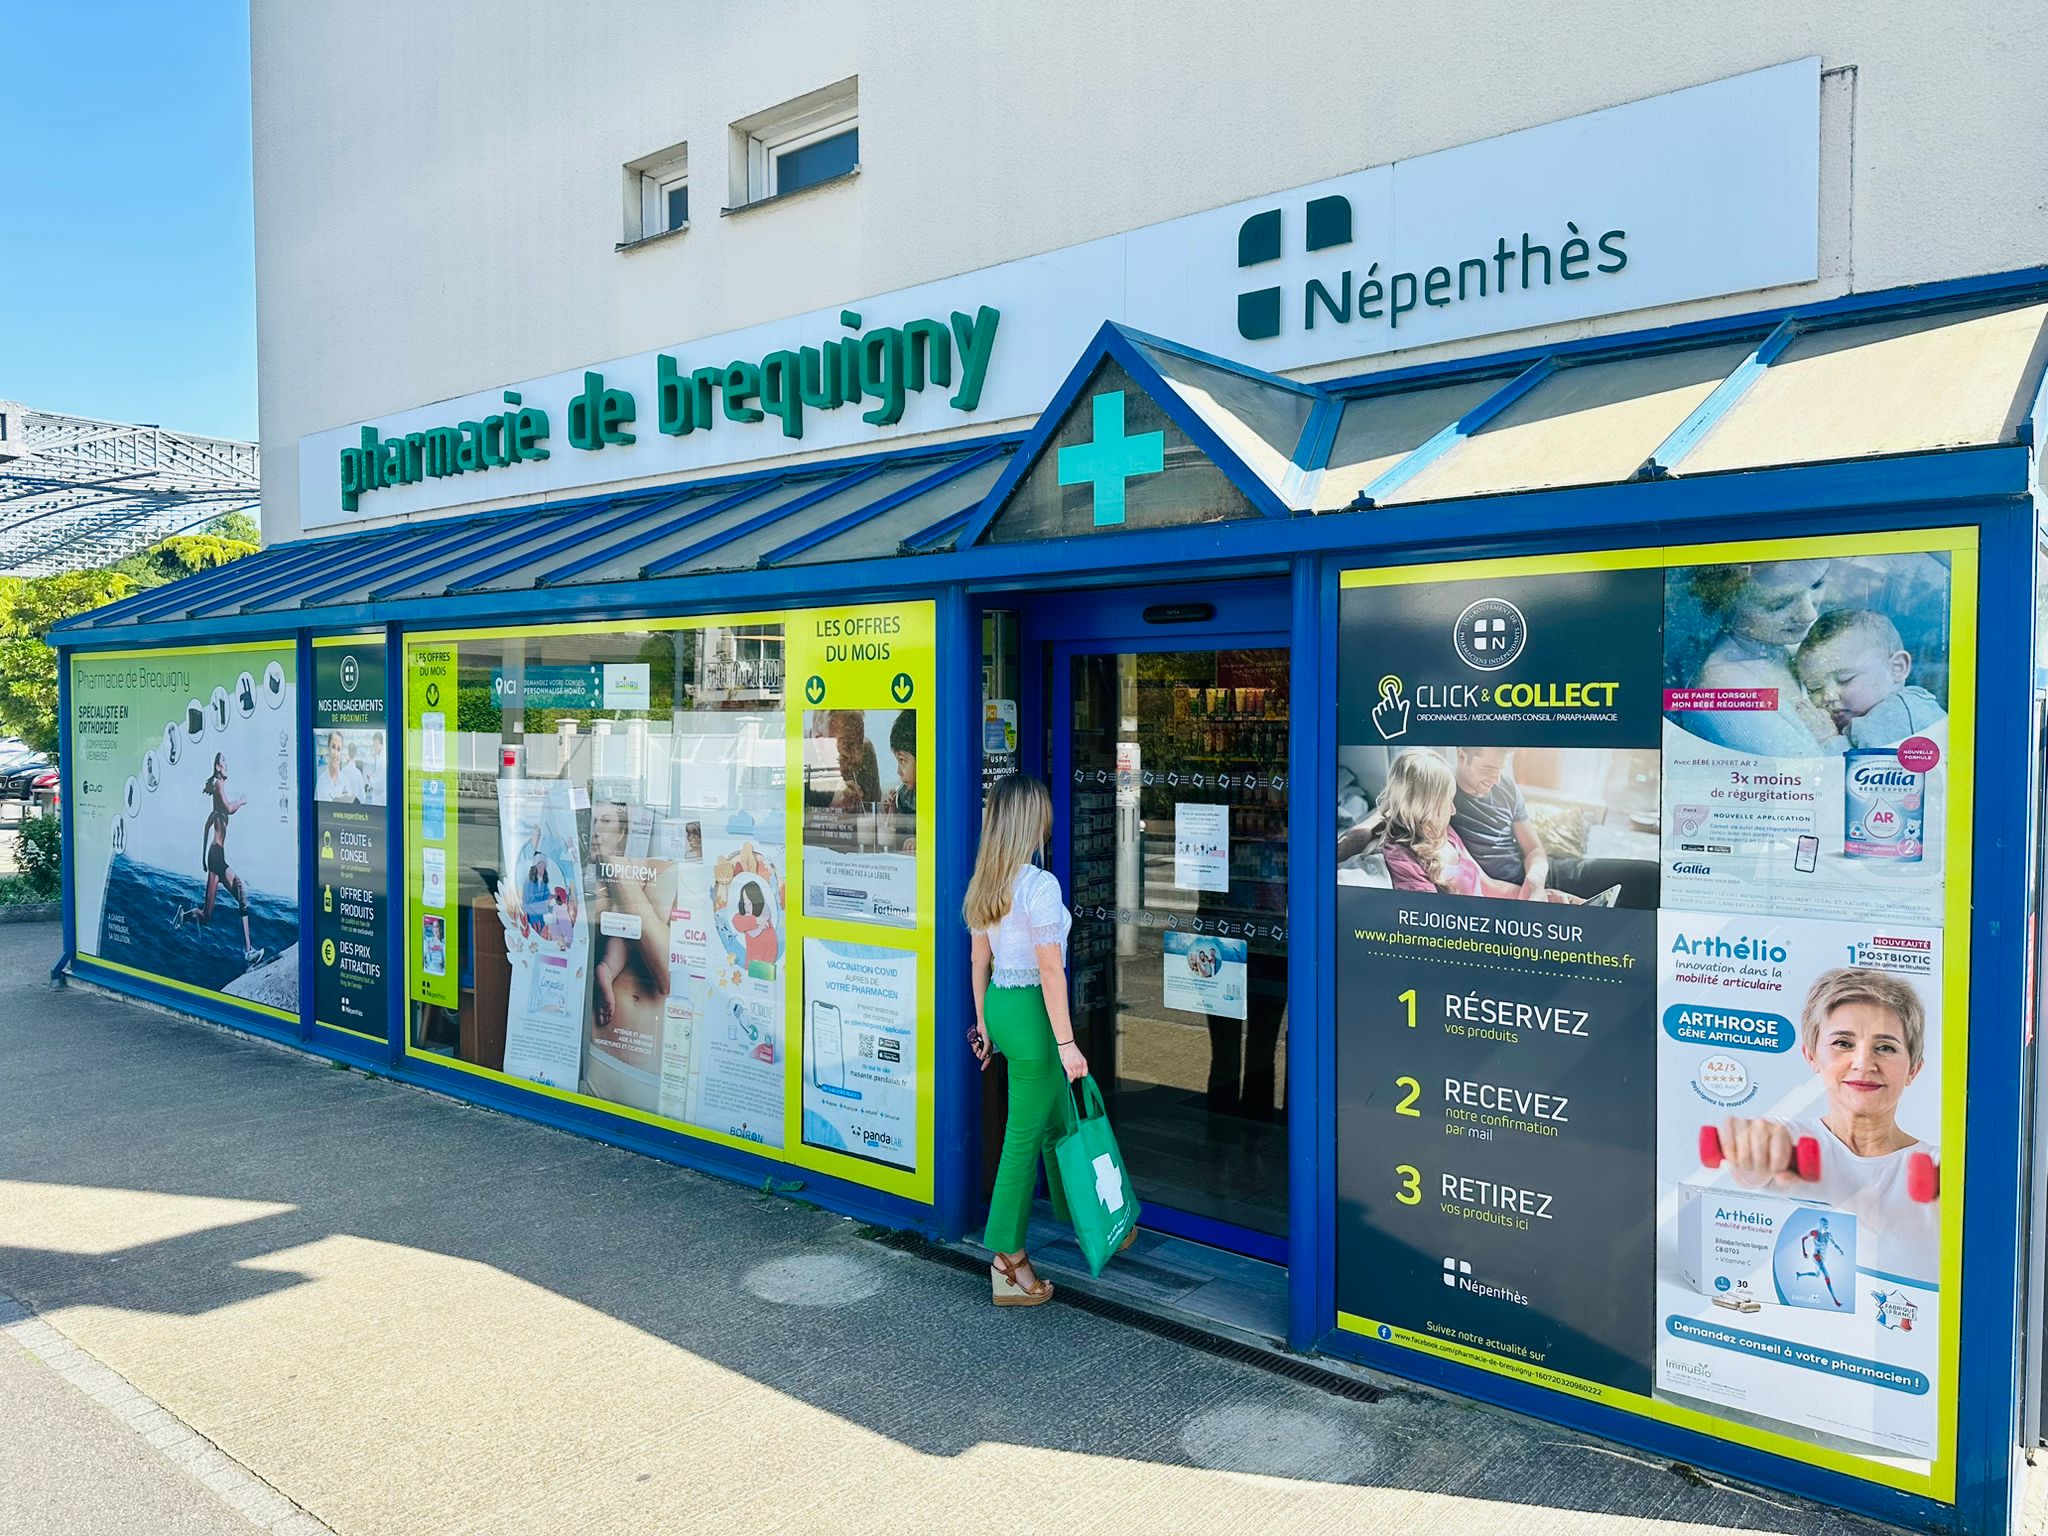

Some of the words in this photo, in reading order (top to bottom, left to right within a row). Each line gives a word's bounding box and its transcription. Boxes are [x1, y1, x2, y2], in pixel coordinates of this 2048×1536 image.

[1304, 221, 1628, 329] Népenthès
[340, 391, 550, 512] pharmacie
[567, 371, 636, 450] de
[657, 304, 1001, 439] brequigny
[816, 619, 841, 638] LES
[844, 615, 901, 637] OFFRES
[427, 651, 450, 663] OFFRES
[826, 644, 847, 662] DU
[851, 642, 890, 661] MOIS
[77, 668, 124, 690] Pharmacie
[125, 668, 137, 689] de
[139, 667, 191, 693] Brequigny
[420, 666, 429, 676] DU
[430, 665, 447, 676] MOIS
[503, 679, 516, 694] ICI
[1416, 684, 1479, 708] CLICK
[1481, 688, 1491, 702] &
[1494, 682, 1619, 708] COLLECT
[1671, 691, 1688, 700] QUE
[1691, 691, 1715, 700] FAIRE
[1717, 692, 1758, 700] LORSQUE
[119, 705, 129, 719] EN
[318, 699, 332, 711] NOS
[332, 698, 384, 712] ENGAGEMENTS
[1671, 700, 1691, 709] MON
[1692, 699, 1714, 709] BÉBÉ
[1716, 699, 1764, 709] RÉGURGITE
[1766, 700, 1773, 709] ?
[1416, 713, 1468, 721] ORDONNANCES
[1522, 713, 1551, 721] CONSEIL
[1556, 713, 1618, 722] PARAPHARMACIE
[1730, 771, 1749, 785] 3x
[1753, 773, 1802, 786] moins
[1854, 768, 1915, 787] Gallia
[1710, 787, 1725, 798] de
[1728, 788, 1814, 802] régurgitations
[1713, 812, 1754, 820] NOUVELLE
[1757, 814, 1811, 822] APPLICATION
[1872, 811, 1894, 824] AR
[340, 829, 367, 847] ÉCOUTE
[1904, 839, 1916, 854] 2
[340, 848, 369, 864] CONSEIL
[1672, 861, 1712, 875] Gallia
[339, 886, 362, 902] OFFRE
[363, 890, 373, 904] DE
[340, 902, 375, 921] PRODUITS
[684, 928, 708, 942] CICA
[1399, 910, 1490, 933] REJOIGNEZ
[1495, 919, 1543, 938] NOUS
[1547, 924, 1583, 943] SUR
[340, 940, 354, 956] DES
[354, 943, 371, 959] PRIX
[1354, 927, 1637, 970] www.pharmaciedebrequigny.nepenthes.fr
[1671, 933, 1787, 963] Arthélio
[1874, 938, 1930, 949] NOUVEAUTÉ
[1859, 950, 1931, 965] POSTBIOTIC
[340, 957, 381, 978] ATTRACTIFS
[826, 959, 874, 975] VACCINATION
[874, 966, 898, 977] COVID
[1675, 958, 1737, 975] Innovation
[1739, 964, 1768, 977] dans
[1771, 966, 1783, 979] la
[825, 980, 851, 993] VOTRE
[851, 984, 898, 1000] PHARMACIEN
[1675, 972, 1719, 986] mobilité
[1722, 976, 1783, 991] articulaire
[1397, 989, 1417, 1028] 1
[1445, 990, 1590, 1037] RÉSERVEZ
[1678, 1010, 1779, 1036] ARTHROSE
[1444, 1023, 1465, 1036] vos
[1467, 1025, 1519, 1043] produits
[1677, 1025, 1707, 1040] GÊNE
[1708, 1031, 1780, 1049] ARTICULAIRE
[1394, 1076, 1421, 1118] 2
[1444, 1077, 1569, 1122] RECEVEZ
[1445, 1107, 1478, 1123] notre
[1480, 1113, 1559, 1137] confirmation
[1445, 1123, 1465, 1137] par
[1467, 1127, 1494, 1142] mail
[1394, 1164, 1422, 1206] 3
[1442, 1173, 1553, 1220] RETIREZ
[1440, 1202, 1461, 1216] vos
[1463, 1205, 1514, 1229] produits
[1515, 1216, 1529, 1231] ici
[1714, 1207, 1773, 1226] Arthélio
[1459, 1276, 1529, 1306] Népenthès
[1736, 1279, 1749, 1289] 30
[1426, 1320, 1457, 1338] Suivez
[1458, 1328, 1484, 1345] notre
[1485, 1336, 1528, 1357] actualité
[1529, 1349, 1547, 1361] sur
[1673, 1320, 1737, 1344] Demandez
[1739, 1337, 1781, 1356] conseil
[1783, 1345, 1793, 1358] à
[1795, 1351, 1829, 1367] votre
[1831, 1358, 1912, 1387] pharmacien
[1915, 1377, 1921, 1388] !
[1665, 1360, 1712, 1378] ImmuBio
